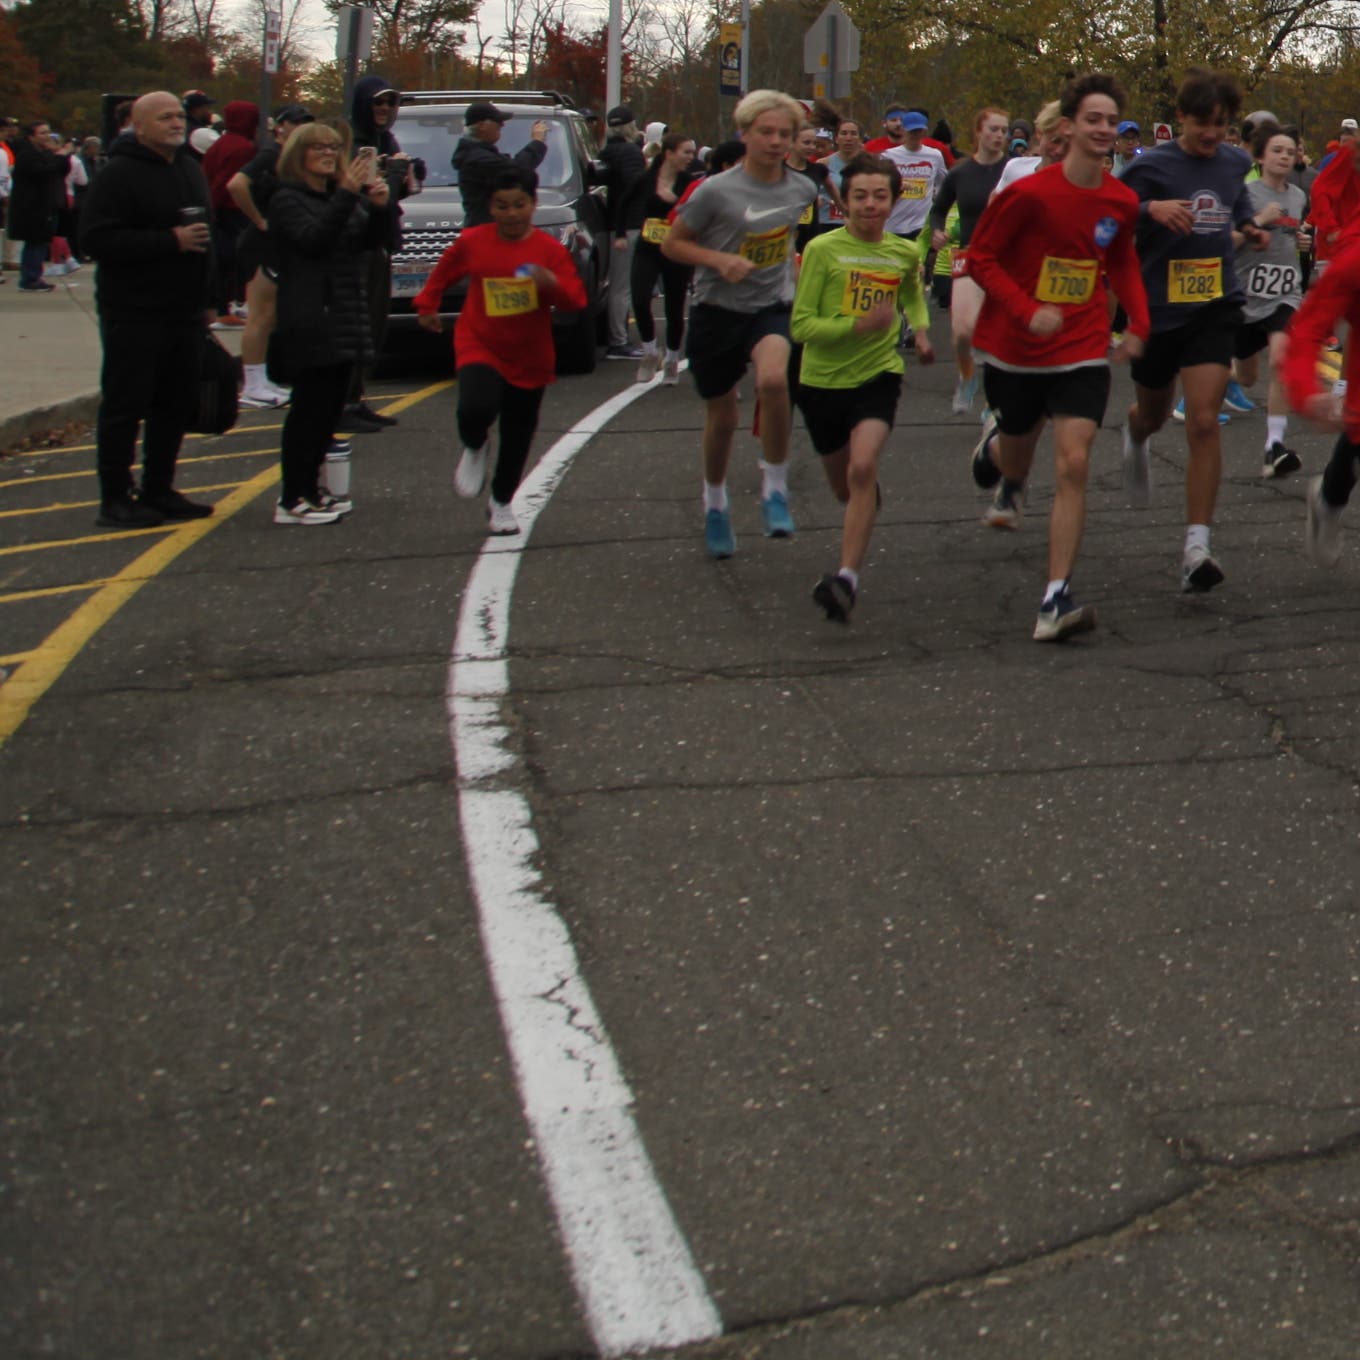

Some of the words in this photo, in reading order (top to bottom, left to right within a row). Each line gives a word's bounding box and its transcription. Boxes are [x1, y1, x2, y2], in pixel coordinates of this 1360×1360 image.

[1050, 276, 1088, 296] 1700
[1179, 275, 1215, 294] 1282
[1251, 265, 1295, 295] 628
[494, 290, 529, 309] 1298
